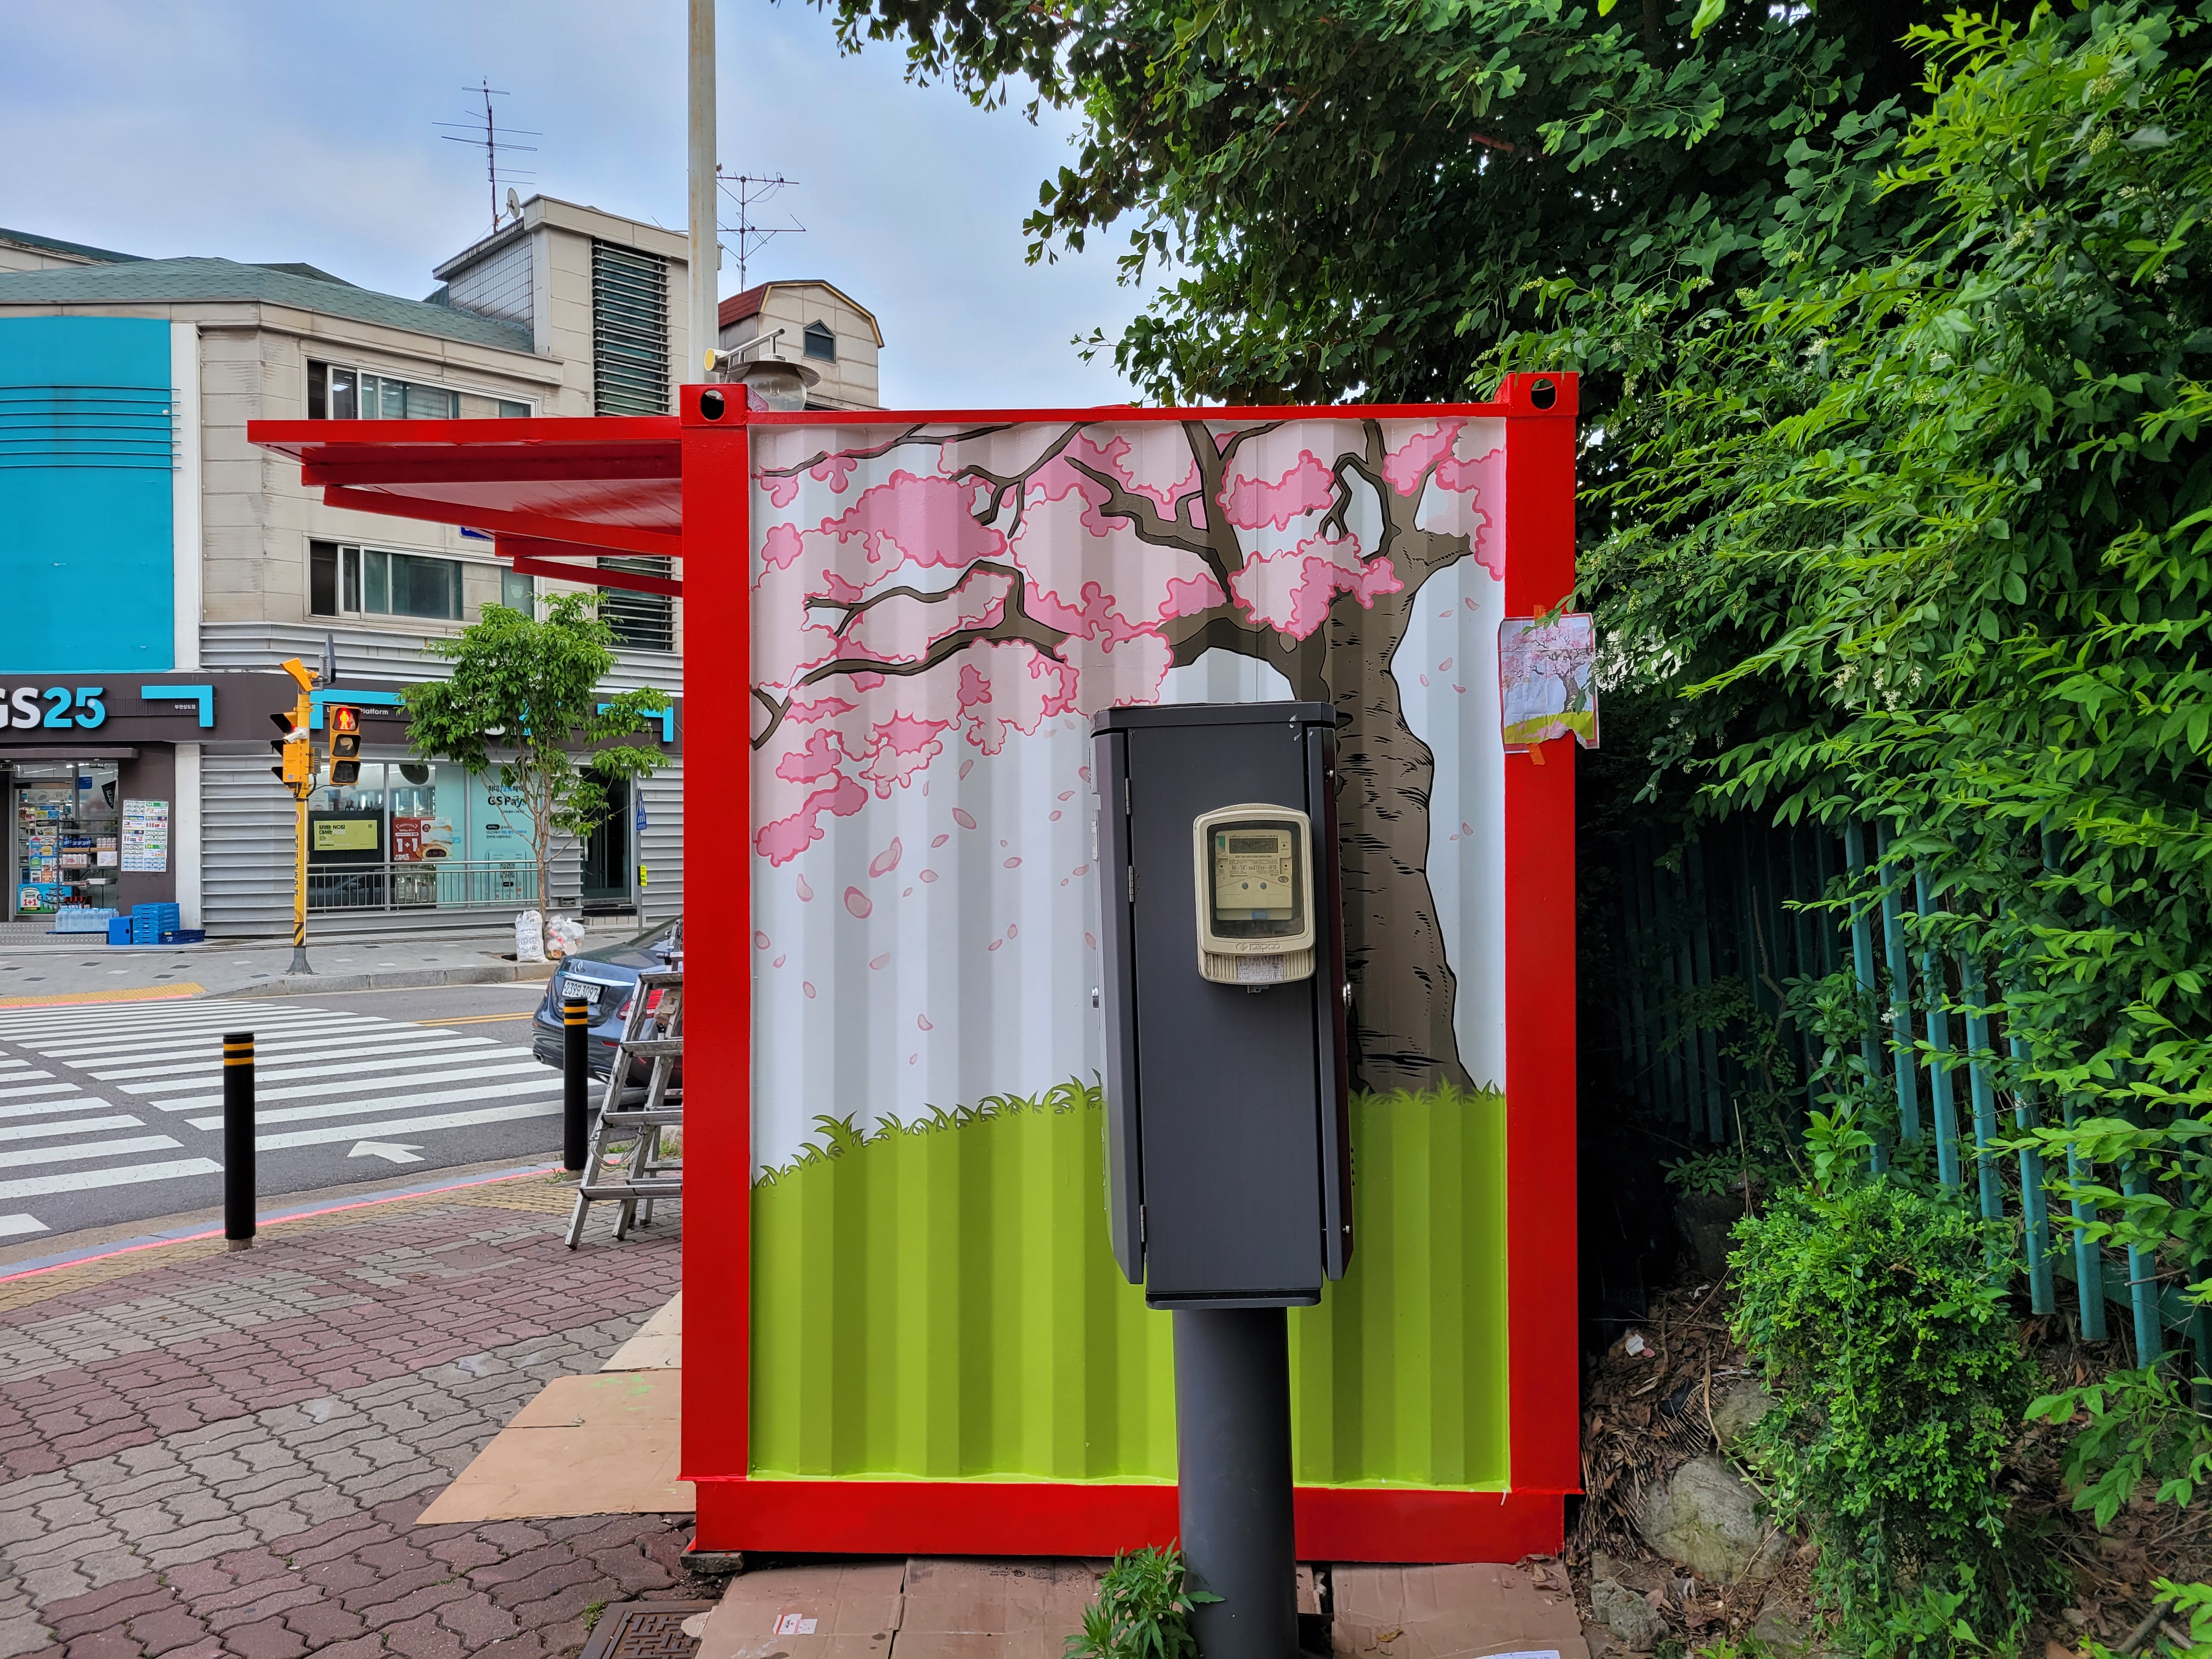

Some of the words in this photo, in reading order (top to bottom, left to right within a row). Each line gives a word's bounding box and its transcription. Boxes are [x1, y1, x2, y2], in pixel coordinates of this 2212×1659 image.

[0, 687, 105, 729] S25
[488, 796, 503, 805] GS
[397, 838, 418, 853] 1+1
